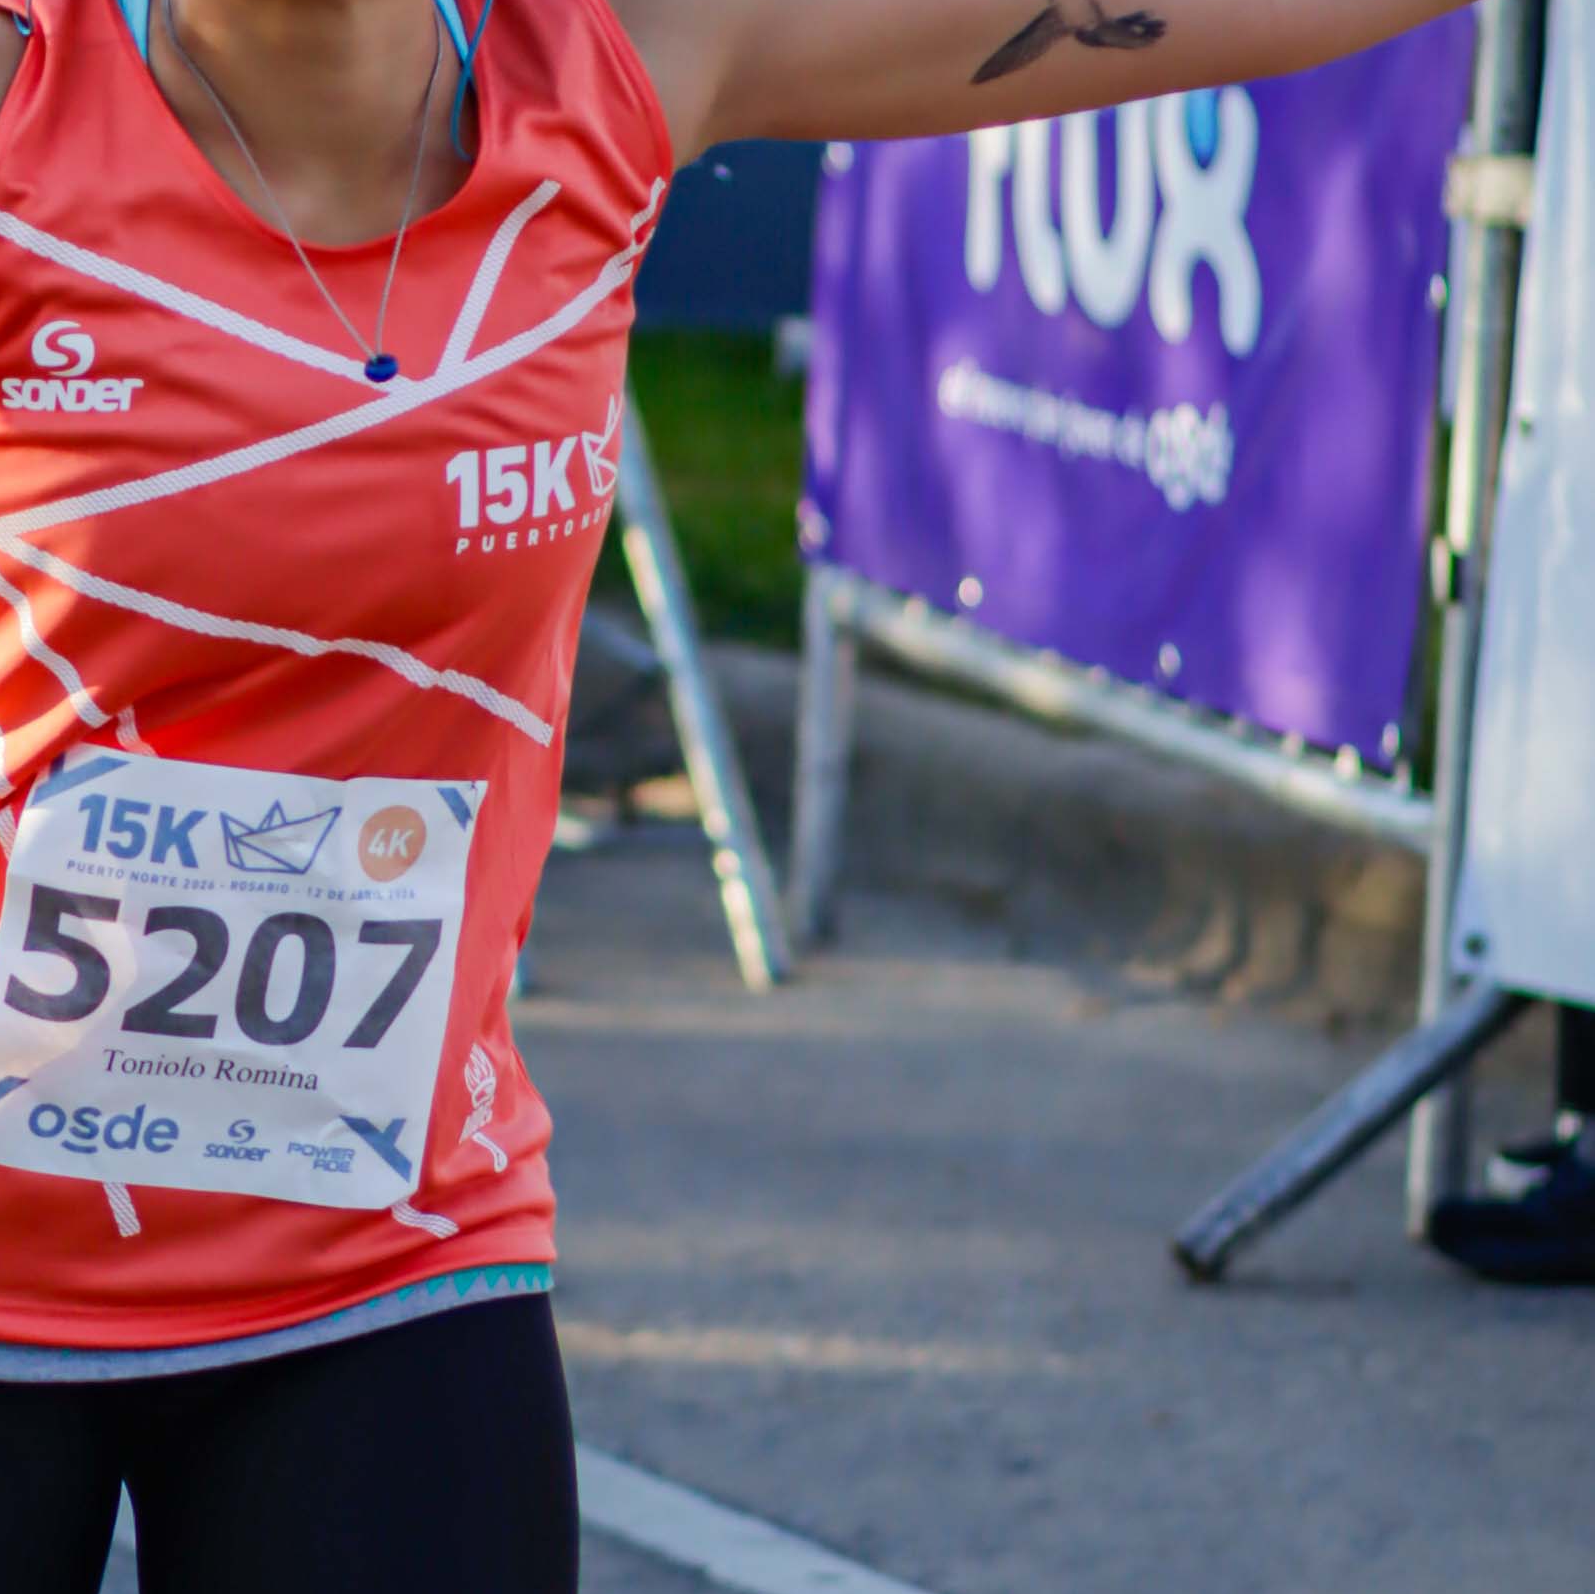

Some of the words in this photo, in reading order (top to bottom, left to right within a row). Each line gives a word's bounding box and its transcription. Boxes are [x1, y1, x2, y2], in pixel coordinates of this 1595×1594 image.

[446, 436, 578, 528] 15K
[456, 519, 574, 555] PUERTO
[77, 794, 208, 869] 15K
[368, 828, 414, 858] 4K
[67, 860, 124, 879] PUERTO
[130, 870, 177, 887] NORTE
[230, 880, 290, 894] ROSARIO
[3, 884, 443, 1050] 5207
[104, 1048, 205, 1079] Toniolo
[214, 1059, 318, 1092] Romina
[29, 1102, 179, 1154] osde
[287, 1141, 355, 1161] POWER
